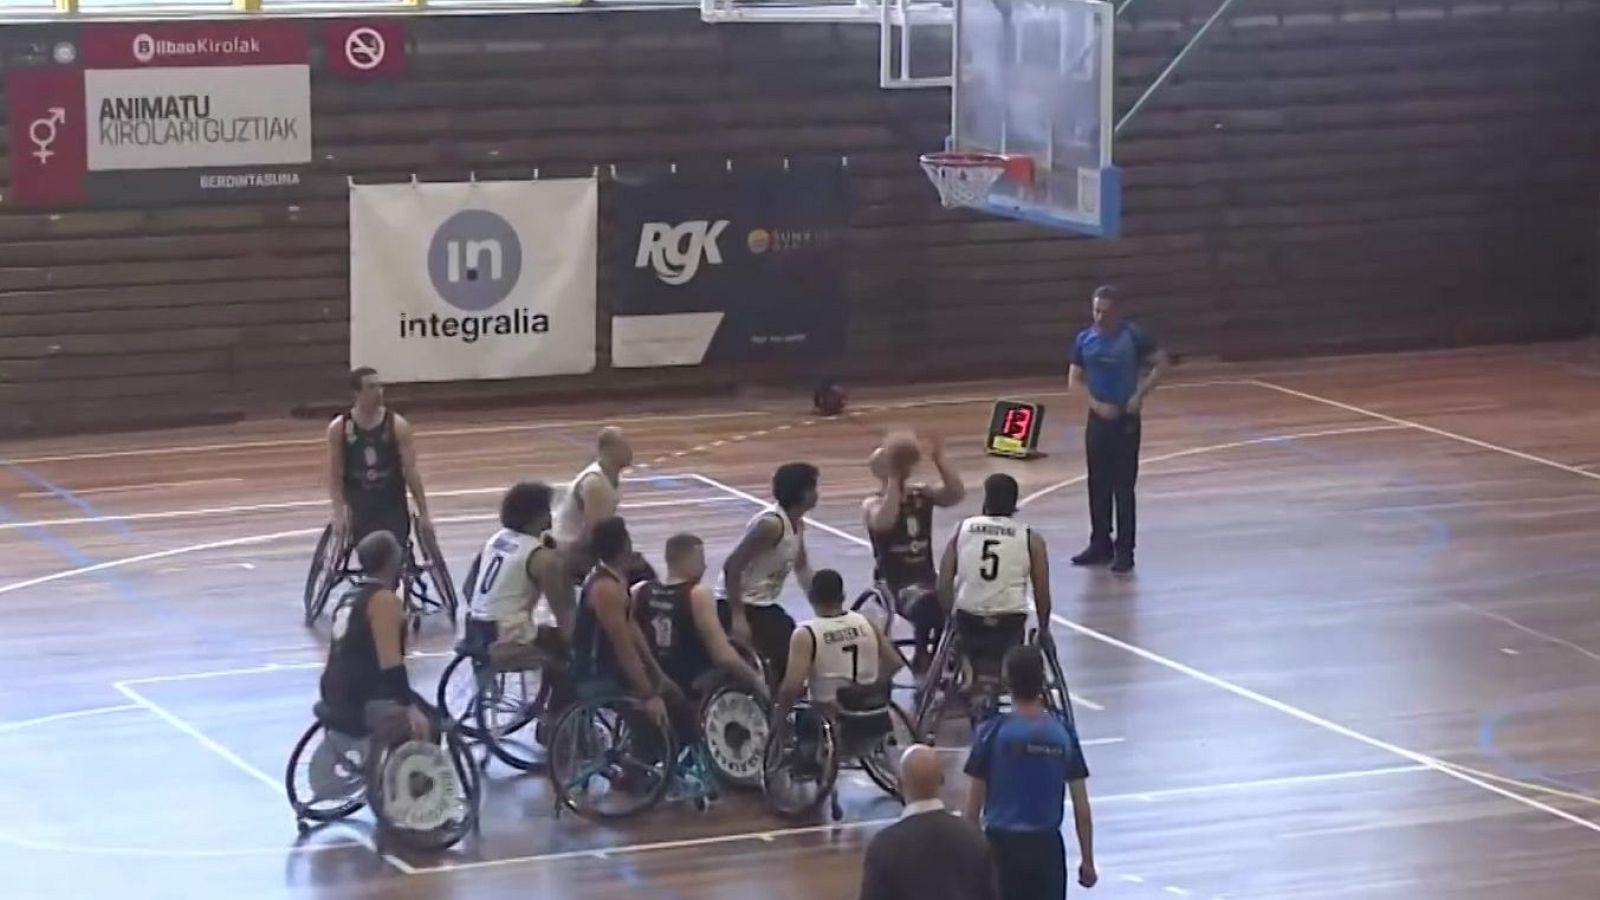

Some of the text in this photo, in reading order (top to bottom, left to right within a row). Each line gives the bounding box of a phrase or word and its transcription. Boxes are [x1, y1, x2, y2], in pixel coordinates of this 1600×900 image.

[99, 95, 210, 121] ANIMATU
[99, 117, 298, 146] KIROLARI GUZTIAK
[200, 173, 300, 189] BERDINTASUNA
[447, 238, 503, 283] in
[635, 219, 731, 285] RGK
[400, 308, 549, 343] integralia
[1003, 407, 1031, 440] 13
[480, 556, 504, 594] 0
[980, 540, 1001, 581] 5
[842, 645, 858, 682] 7
